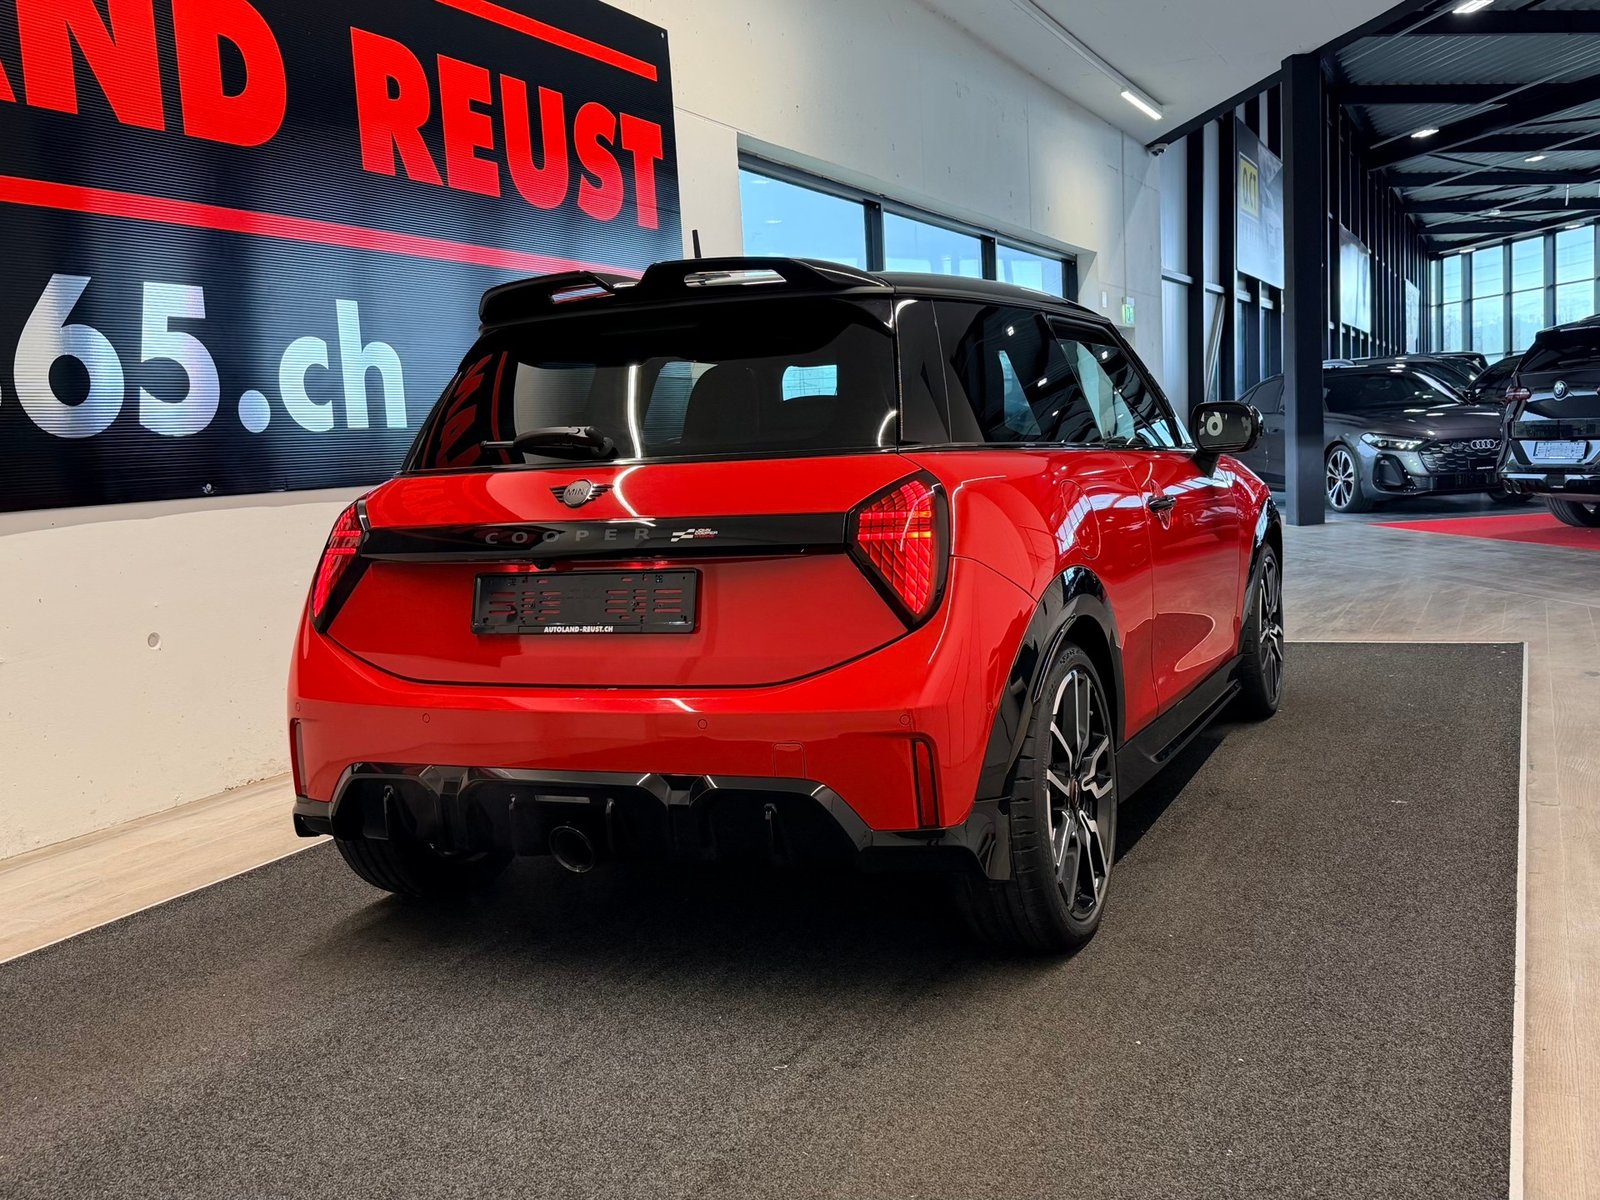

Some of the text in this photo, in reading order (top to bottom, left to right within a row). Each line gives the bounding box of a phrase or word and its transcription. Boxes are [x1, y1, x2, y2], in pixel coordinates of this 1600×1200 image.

[0, 0, 663, 230] ND REUST
[0, 274, 407, 438] 65.ch
[485, 527, 650, 544] COOPER
[543, 625, 614, 633] AUTOLAND-REUST.CH
